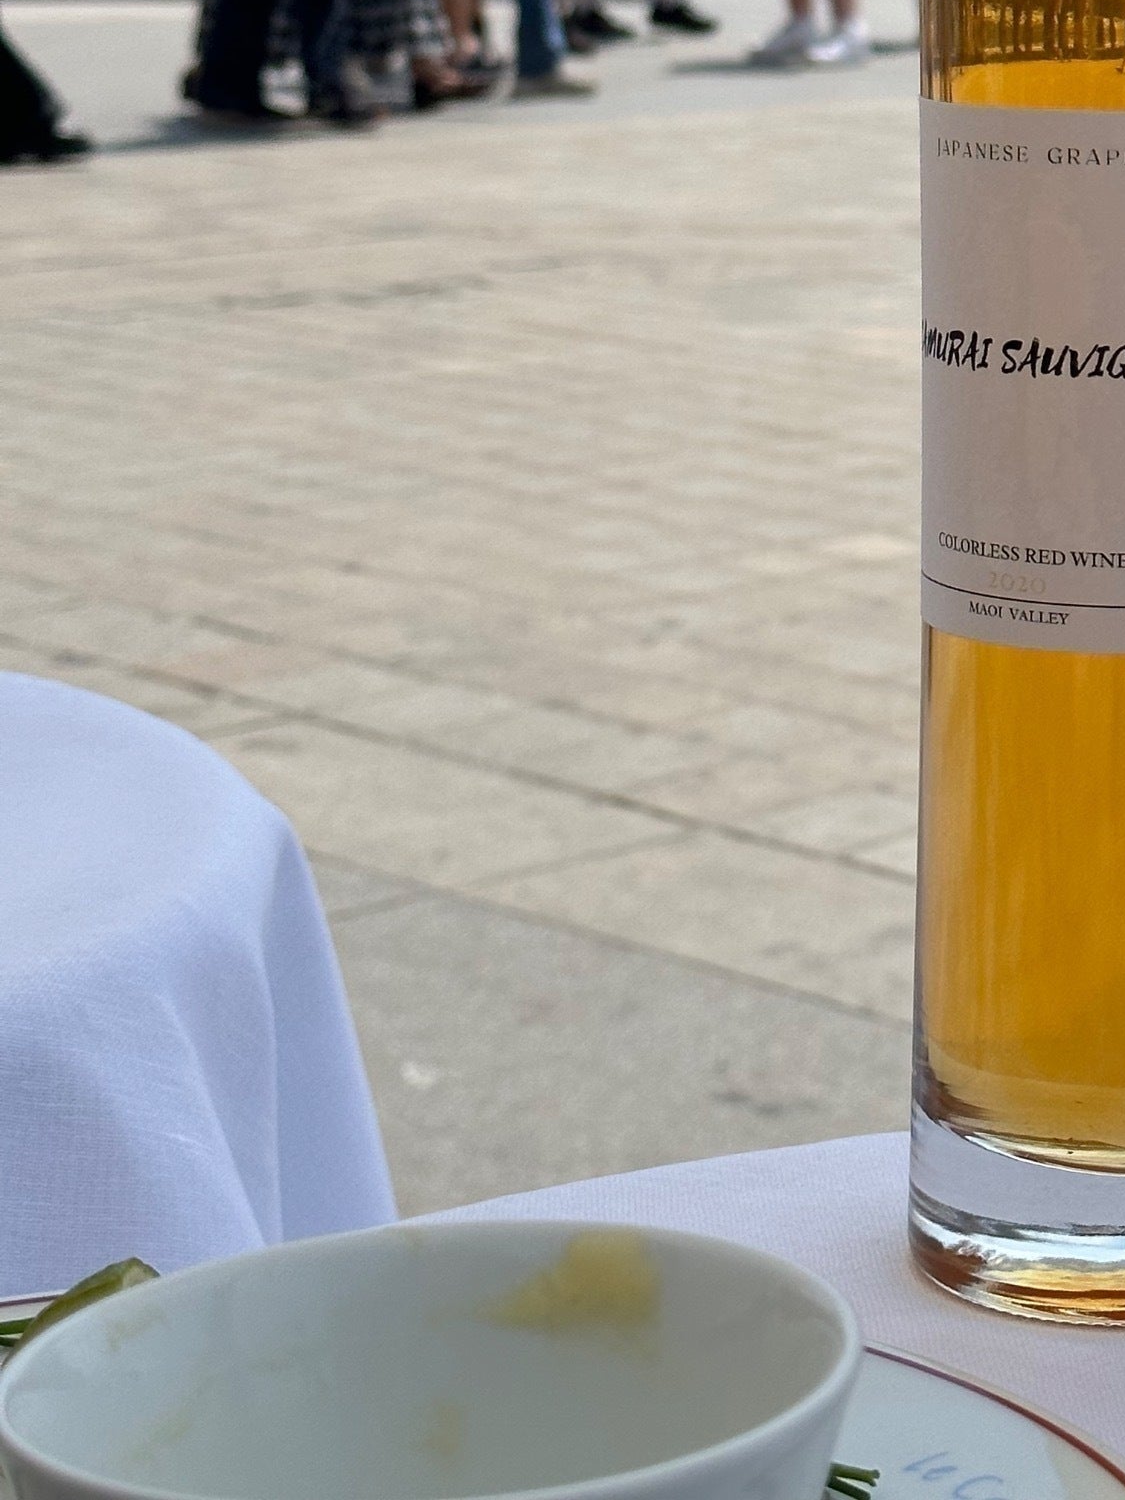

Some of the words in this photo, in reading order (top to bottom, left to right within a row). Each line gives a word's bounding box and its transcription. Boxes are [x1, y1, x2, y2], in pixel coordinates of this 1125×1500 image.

[937, 137, 1029, 163] JAPANESE
[938, 531, 1020, 562] COLORLESS
[1024, 547, 1066, 566] RED
[989, 571, 1047, 594] 2020
[968, 600, 1002, 619] MAOI
[1009, 607, 1070, 625] VALLEY
